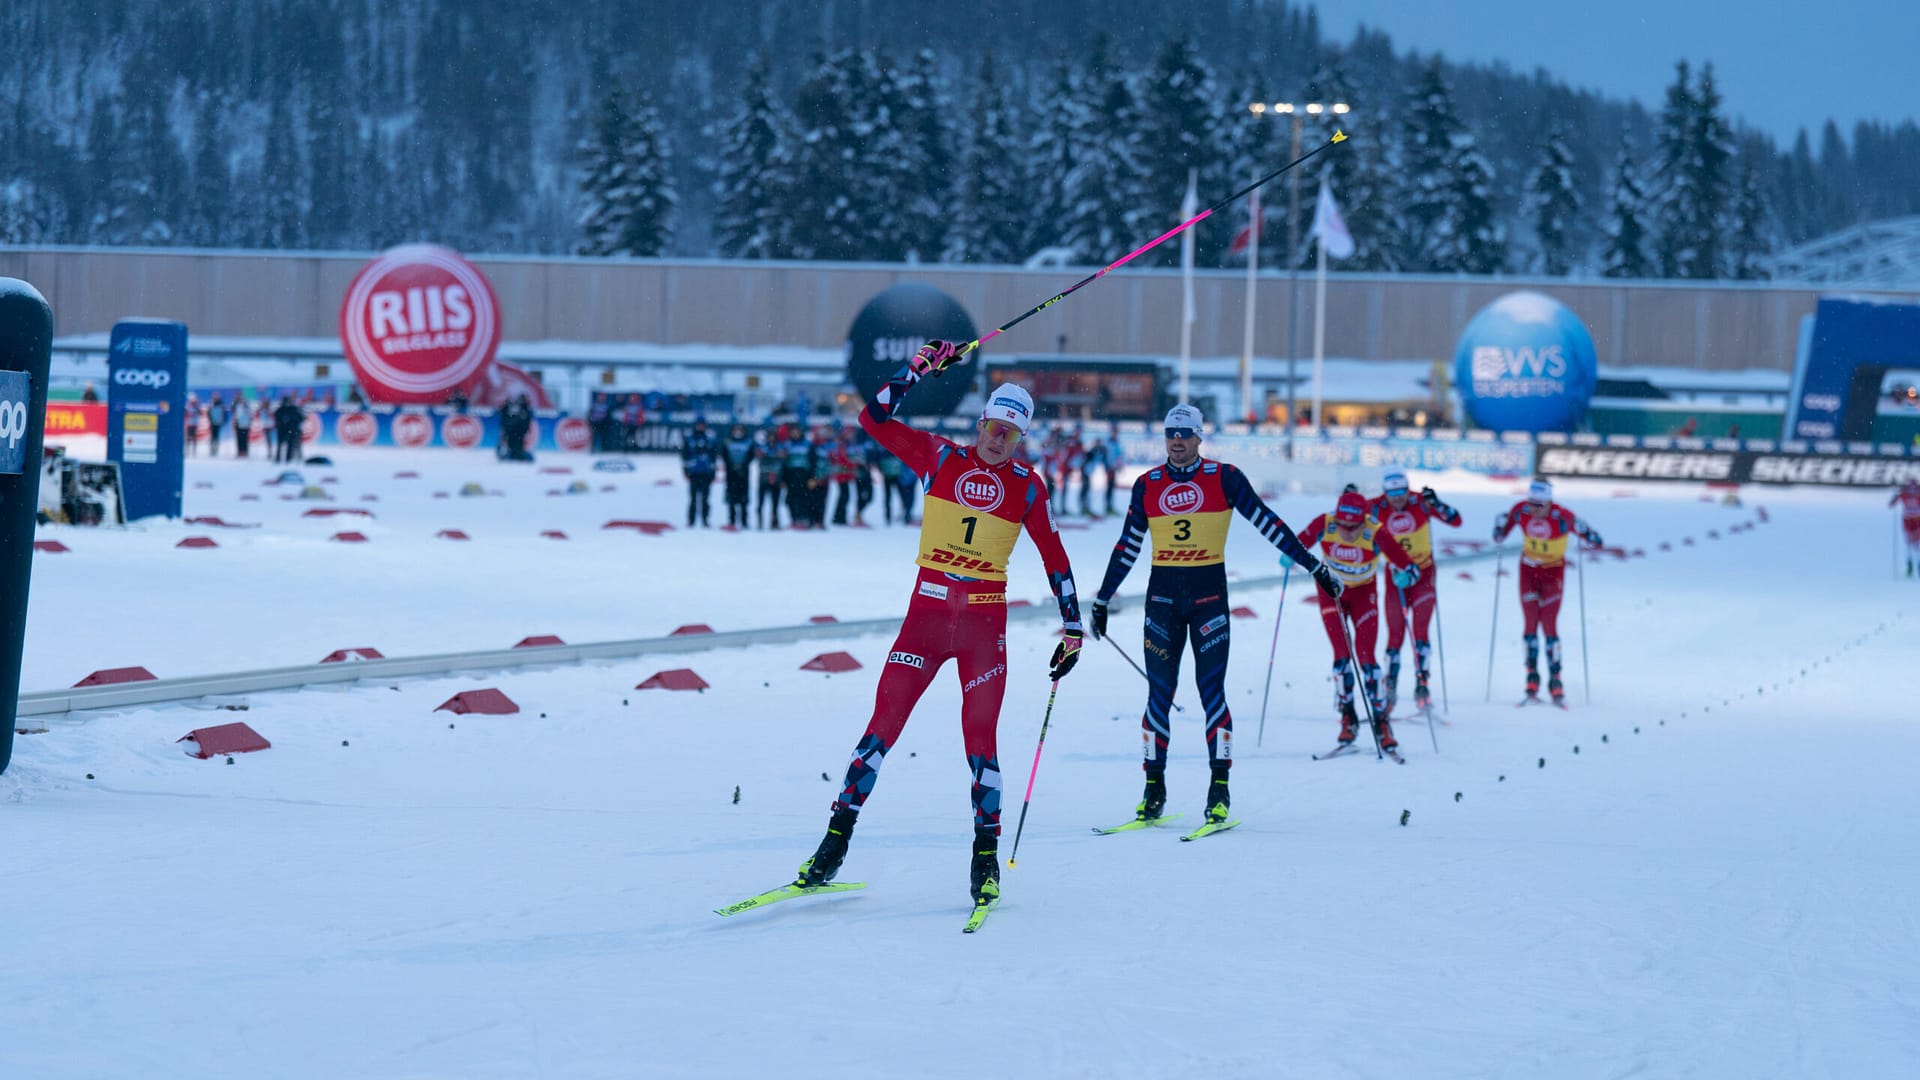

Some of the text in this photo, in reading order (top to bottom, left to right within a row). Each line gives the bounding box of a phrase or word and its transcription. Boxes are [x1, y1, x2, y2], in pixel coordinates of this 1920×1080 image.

[370, 284, 473, 338] RIIS
[382, 332, 467, 355] BILGLASS
[1503, 345, 1567, 378] VVS
[114, 369, 171, 389] coop
[994, 398, 1026, 413] SpareBank
[1540, 450, 1734, 479] SKECHERS
[964, 481, 997, 498] RIIS
[1167, 490, 1197, 506] RIIS
[961, 516, 978, 546] 1
[1174, 519, 1192, 541] 3
[947, 543, 982, 558] TRONDHEIM
[1157, 549, 1211, 562] DHL
[1531, 540, 1548, 553] 11
[929, 547, 996, 573] DHL
[975, 594, 1004, 602] DHL
[1200, 634, 1226, 653] CRAFT
[964, 668, 998, 693] CRAFT
